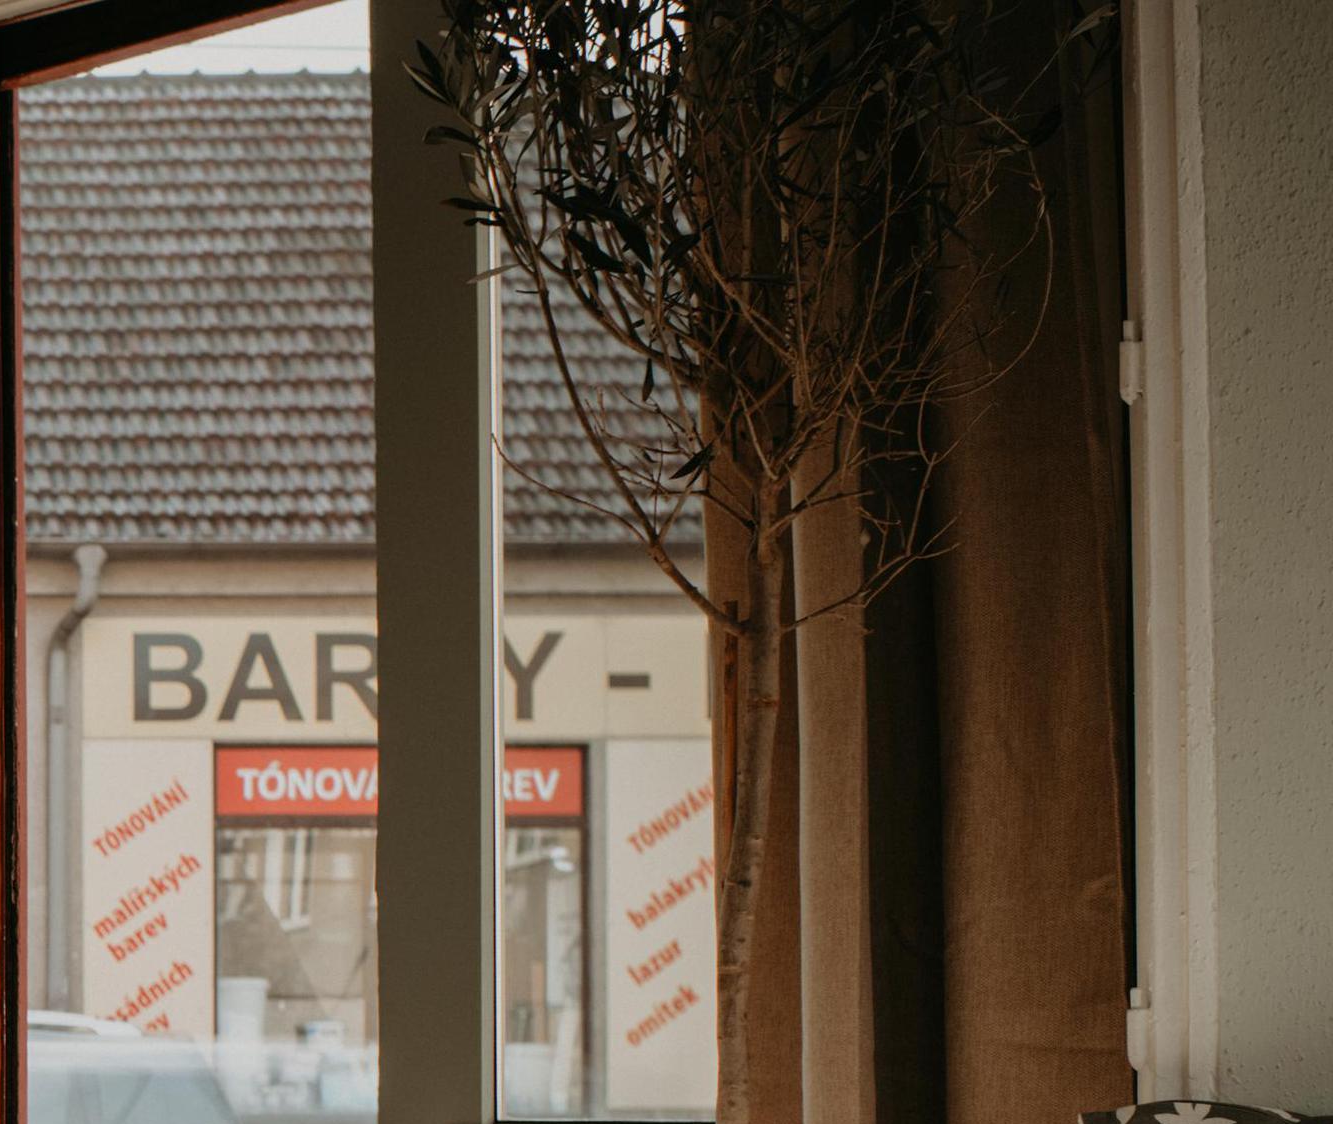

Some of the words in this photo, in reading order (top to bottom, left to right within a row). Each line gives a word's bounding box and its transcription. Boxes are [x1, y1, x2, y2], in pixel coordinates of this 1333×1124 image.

[133, 632, 564, 720] BARY
[628, 781, 714, 852] TÓNOVÁN
[107, 913, 168, 962] barev
[627, 939, 681, 986] lazur
